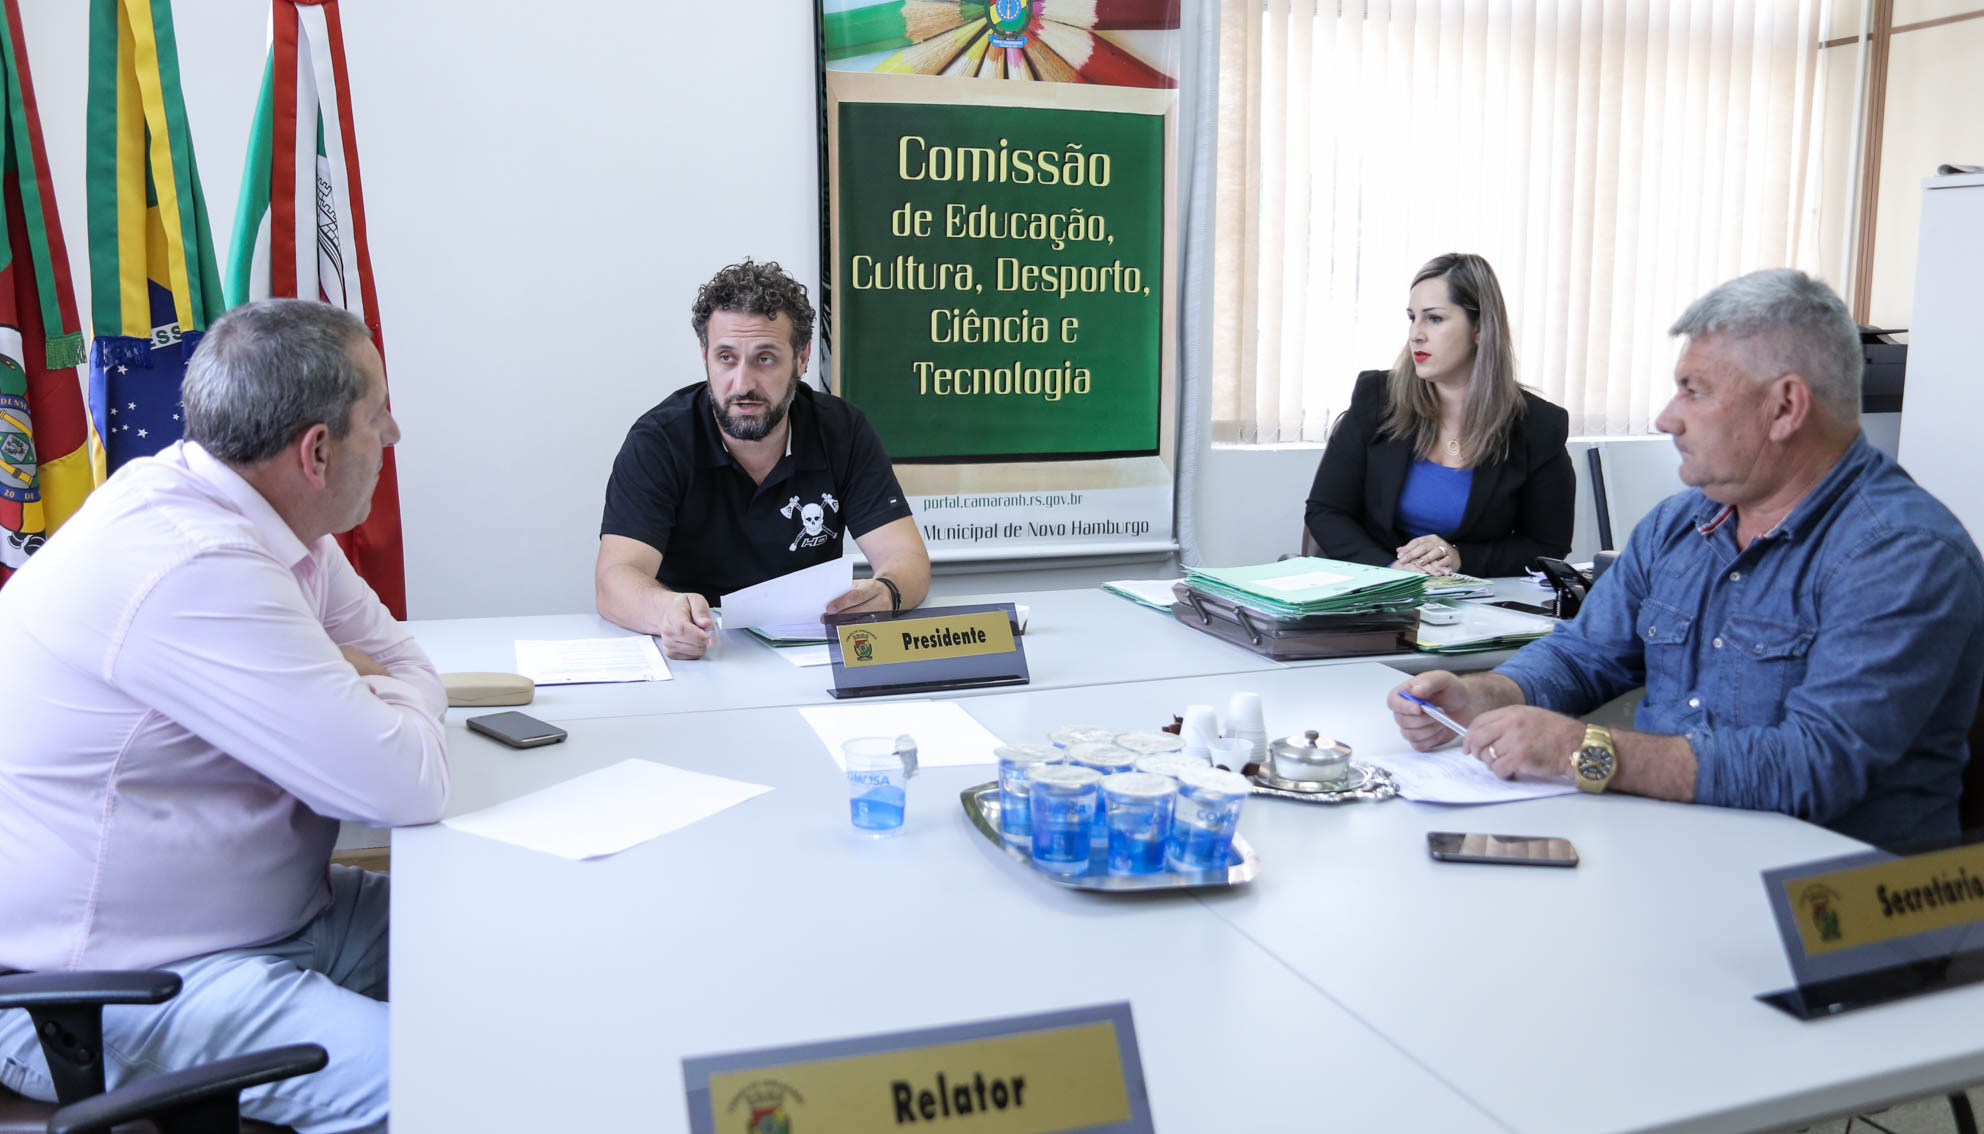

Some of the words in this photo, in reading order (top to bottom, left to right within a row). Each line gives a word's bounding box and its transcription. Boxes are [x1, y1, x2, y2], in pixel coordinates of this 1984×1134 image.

[899, 135, 1111, 187] Comissão
[892, 202, 932, 237] de
[946, 203, 1114, 250] Educação,
[852, 255, 983, 295] Cultura,
[996, 257, 1150, 299] Desporto,
[930, 308, 1049, 343] Ciência
[1061, 317, 1079, 343] e
[913, 360, 1091, 401] Tecnologia
[923, 492, 1083, 511] portal.camaranh.rs.gov.br
[923, 522, 998, 542] Municipal
[1003, 522, 1023, 538] de
[1028, 521, 1066, 537] Novo
[1071, 519, 1150, 536] Hamburgo
[902, 626, 987, 651] Presidente
[891, 1071, 1025, 1124] Relator
